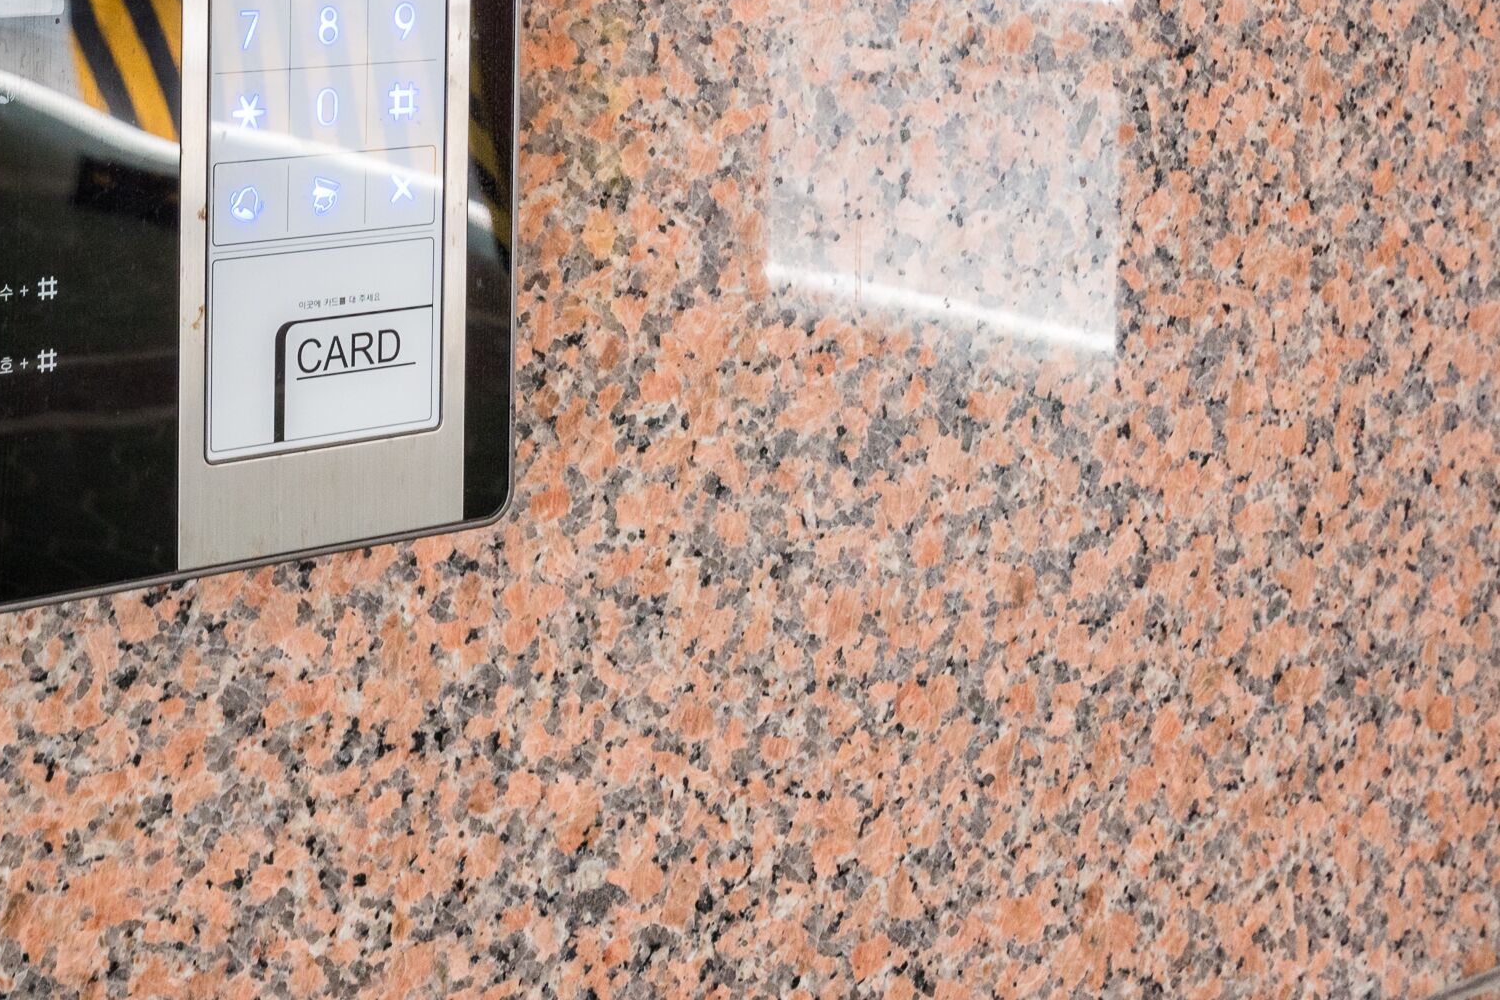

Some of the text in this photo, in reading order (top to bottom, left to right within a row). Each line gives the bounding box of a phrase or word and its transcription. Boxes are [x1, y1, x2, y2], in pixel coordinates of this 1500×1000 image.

[240, 2, 415, 49] 7 8 9
[316, 88, 338, 126] 0
[296, 328, 401, 374] CARD
